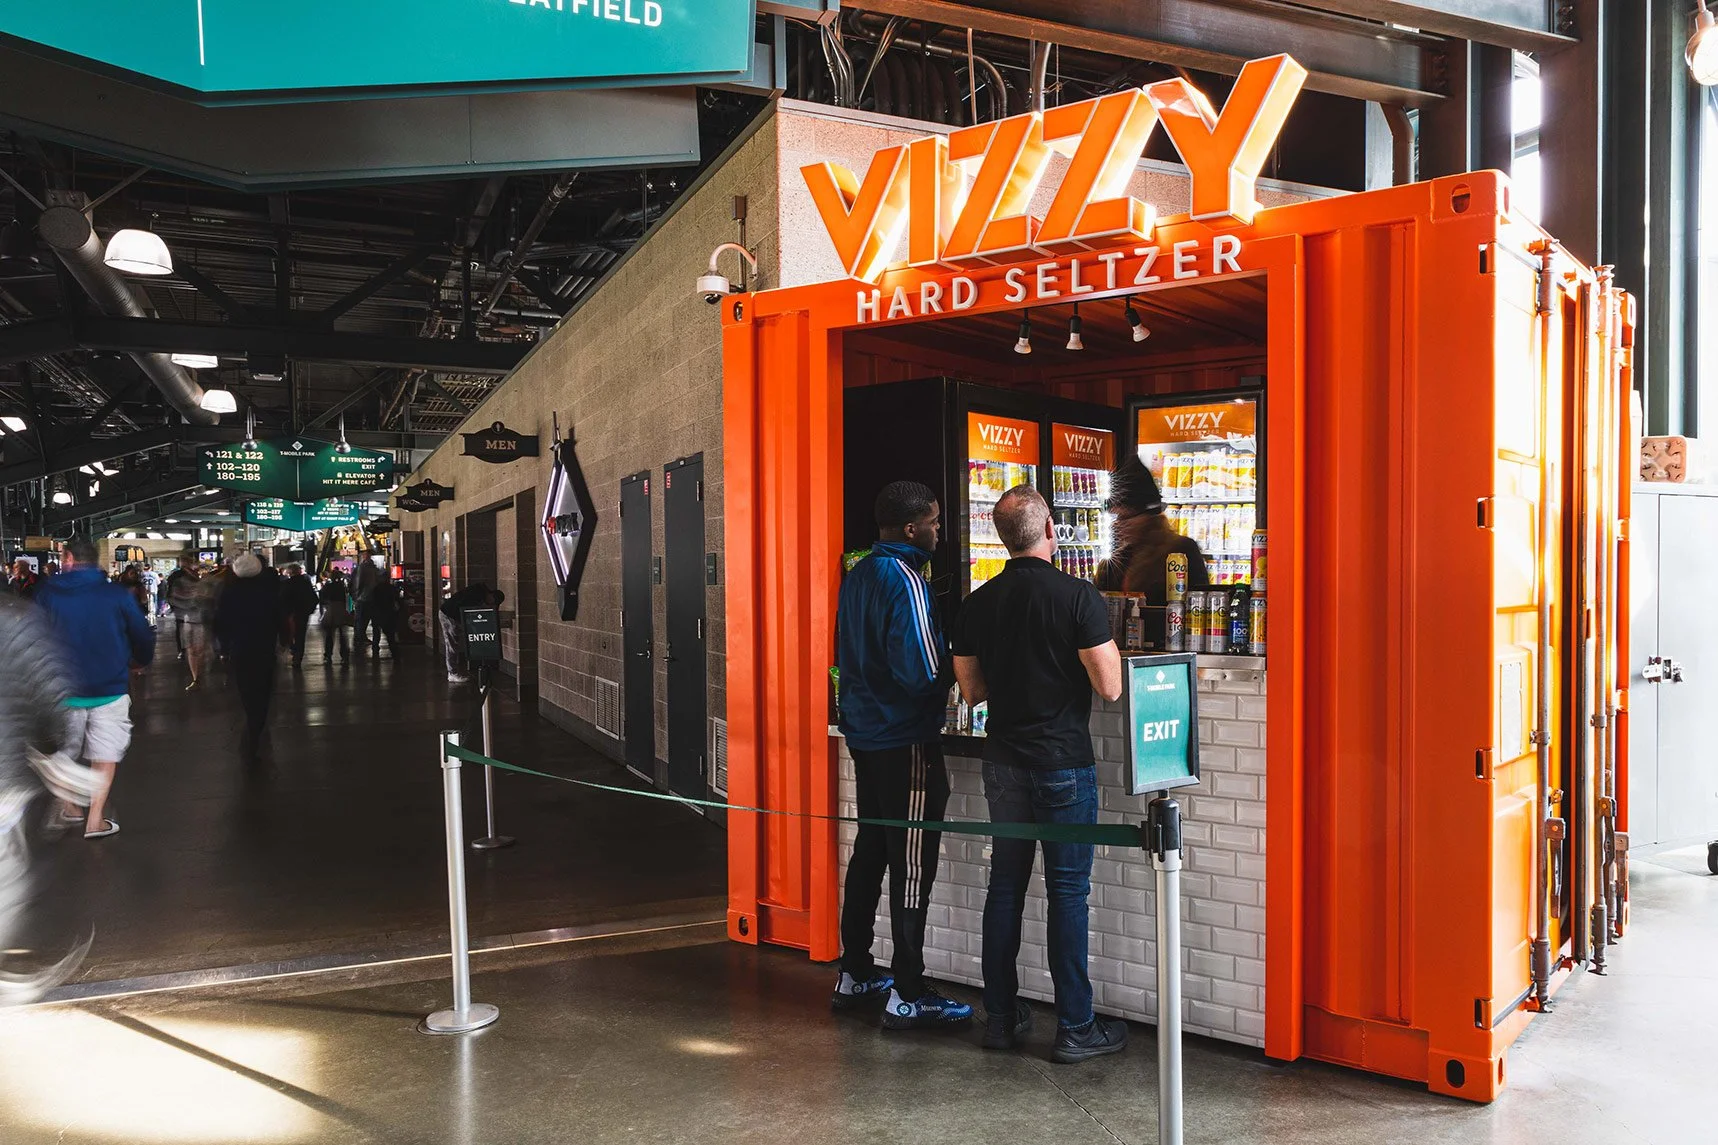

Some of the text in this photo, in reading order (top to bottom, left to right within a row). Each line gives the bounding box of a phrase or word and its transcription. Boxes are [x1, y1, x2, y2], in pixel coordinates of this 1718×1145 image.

[799, 52, 1307, 285] VIZZY
[856, 233, 1243, 323] HARD SELTZER
[1163, 411, 1225, 431] VIZZY
[977, 422, 1024, 447] VIZZY
[486, 440, 517, 450] MEN
[1064, 432, 1103, 455] VIZZY
[999, 445, 1021, 454] SELTZER
[216, 450, 264, 460] 121 & 122
[337, 456, 376, 464] RESTROOMS
[361, 463, 377, 471] EXIT
[420, 489, 440, 497] MEN
[468, 632, 496, 642] ENTRY
[1143, 719, 1180, 742] EXIT
